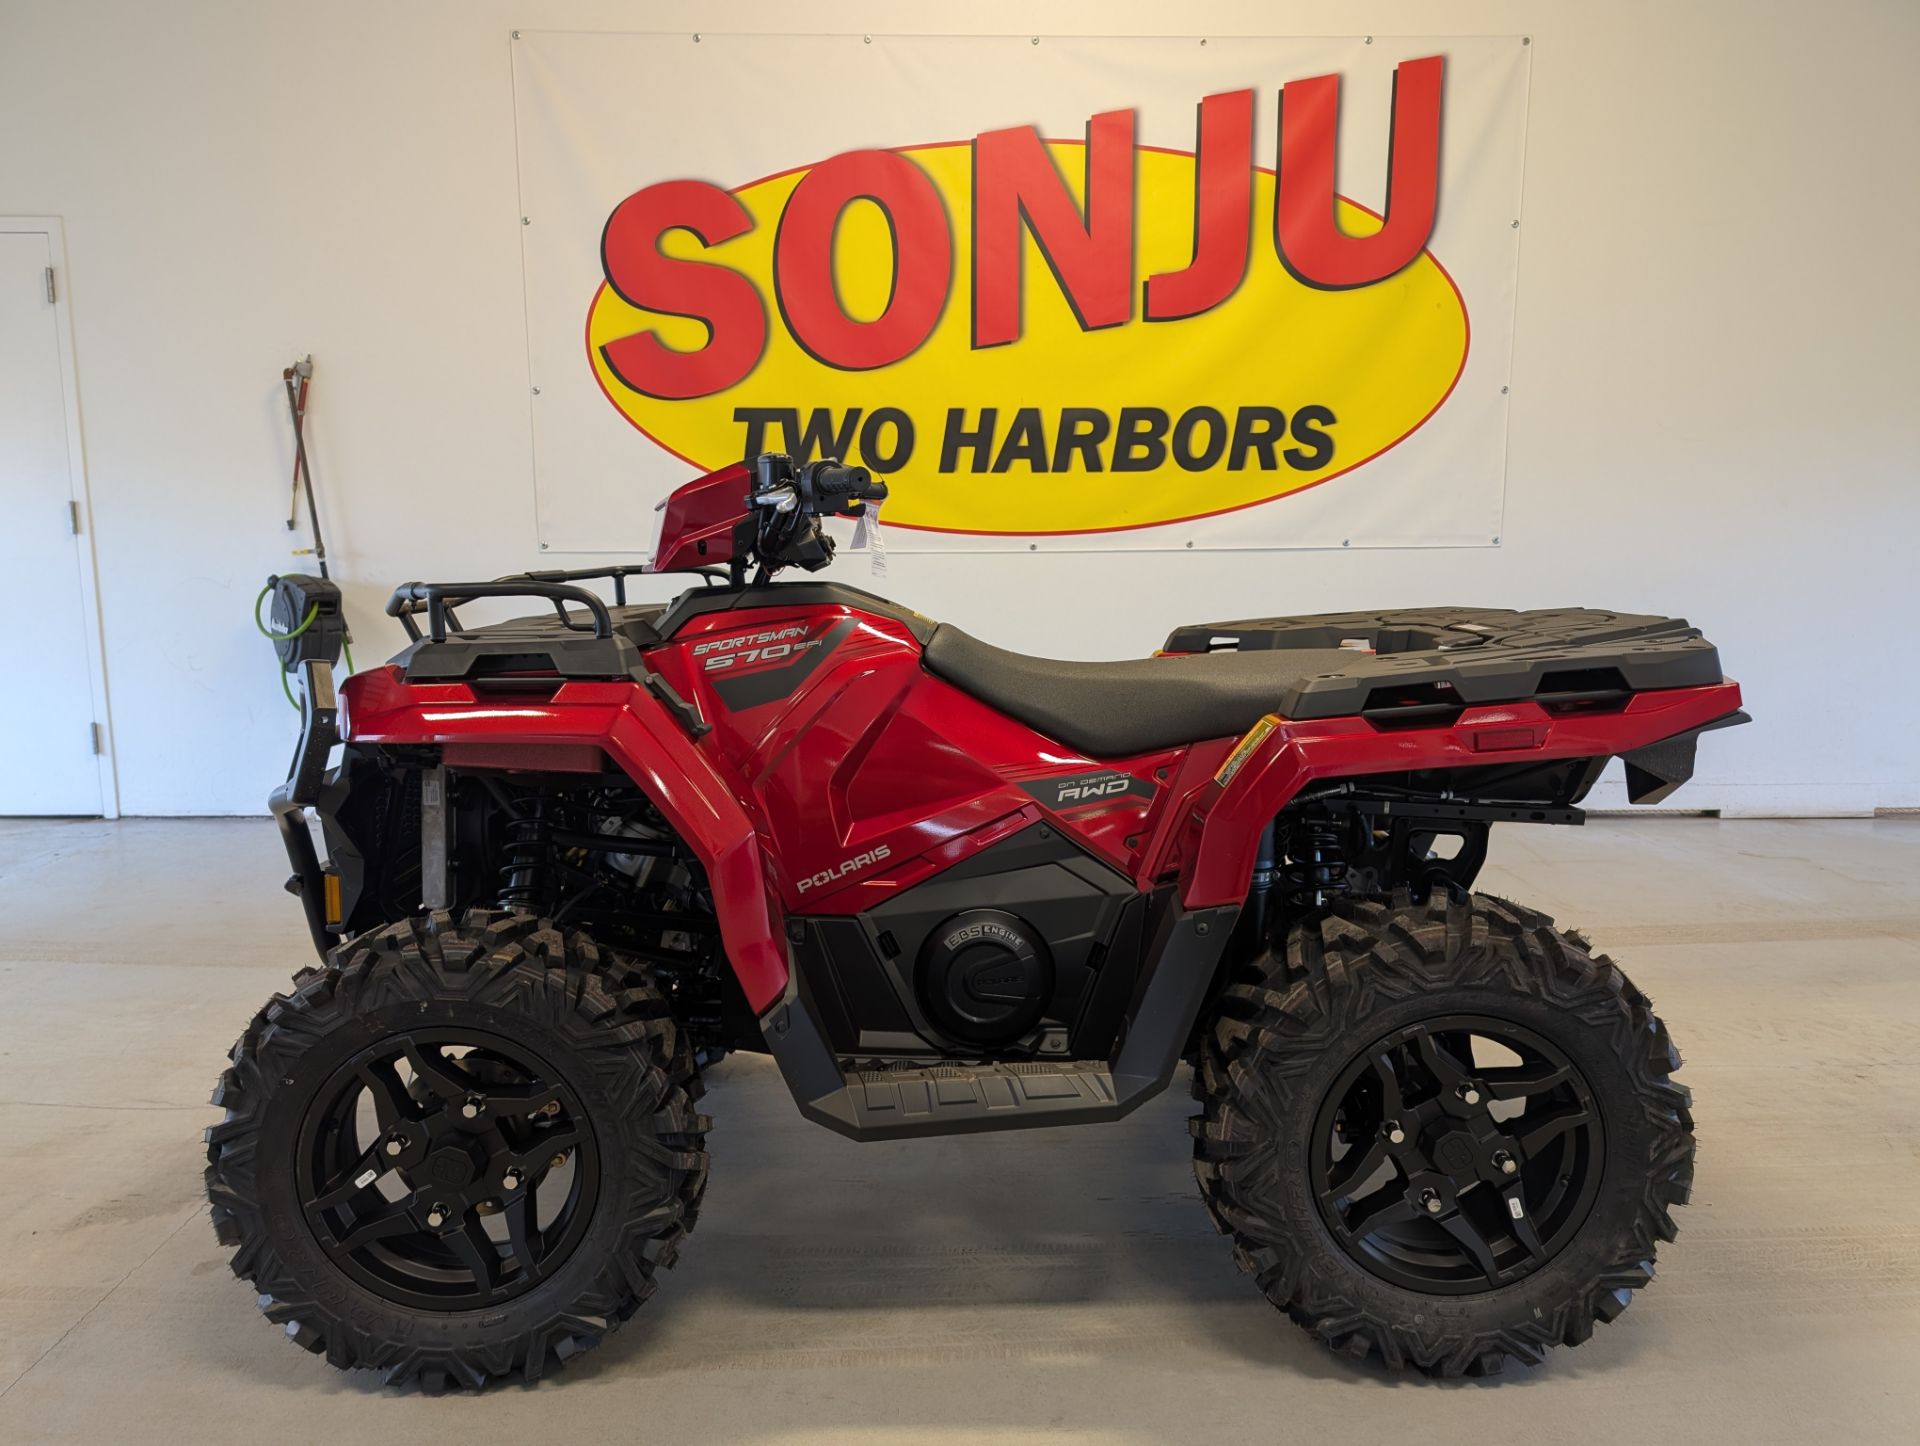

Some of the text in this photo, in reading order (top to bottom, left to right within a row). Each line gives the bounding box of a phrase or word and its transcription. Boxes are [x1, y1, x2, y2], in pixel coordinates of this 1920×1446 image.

[600, 54, 1445, 400] SONJU
[732, 404, 1338, 474] TWO HARBORS
[693, 626, 808, 655] SPORTSMAN
[704, 643, 791, 671] 570
[1057, 779, 1130, 802] AWD
[1058, 772, 1131, 789] ON DEMAND
[797, 844, 892, 894] POLARIS
[949, 924, 1023, 948] EBS ENGINE
